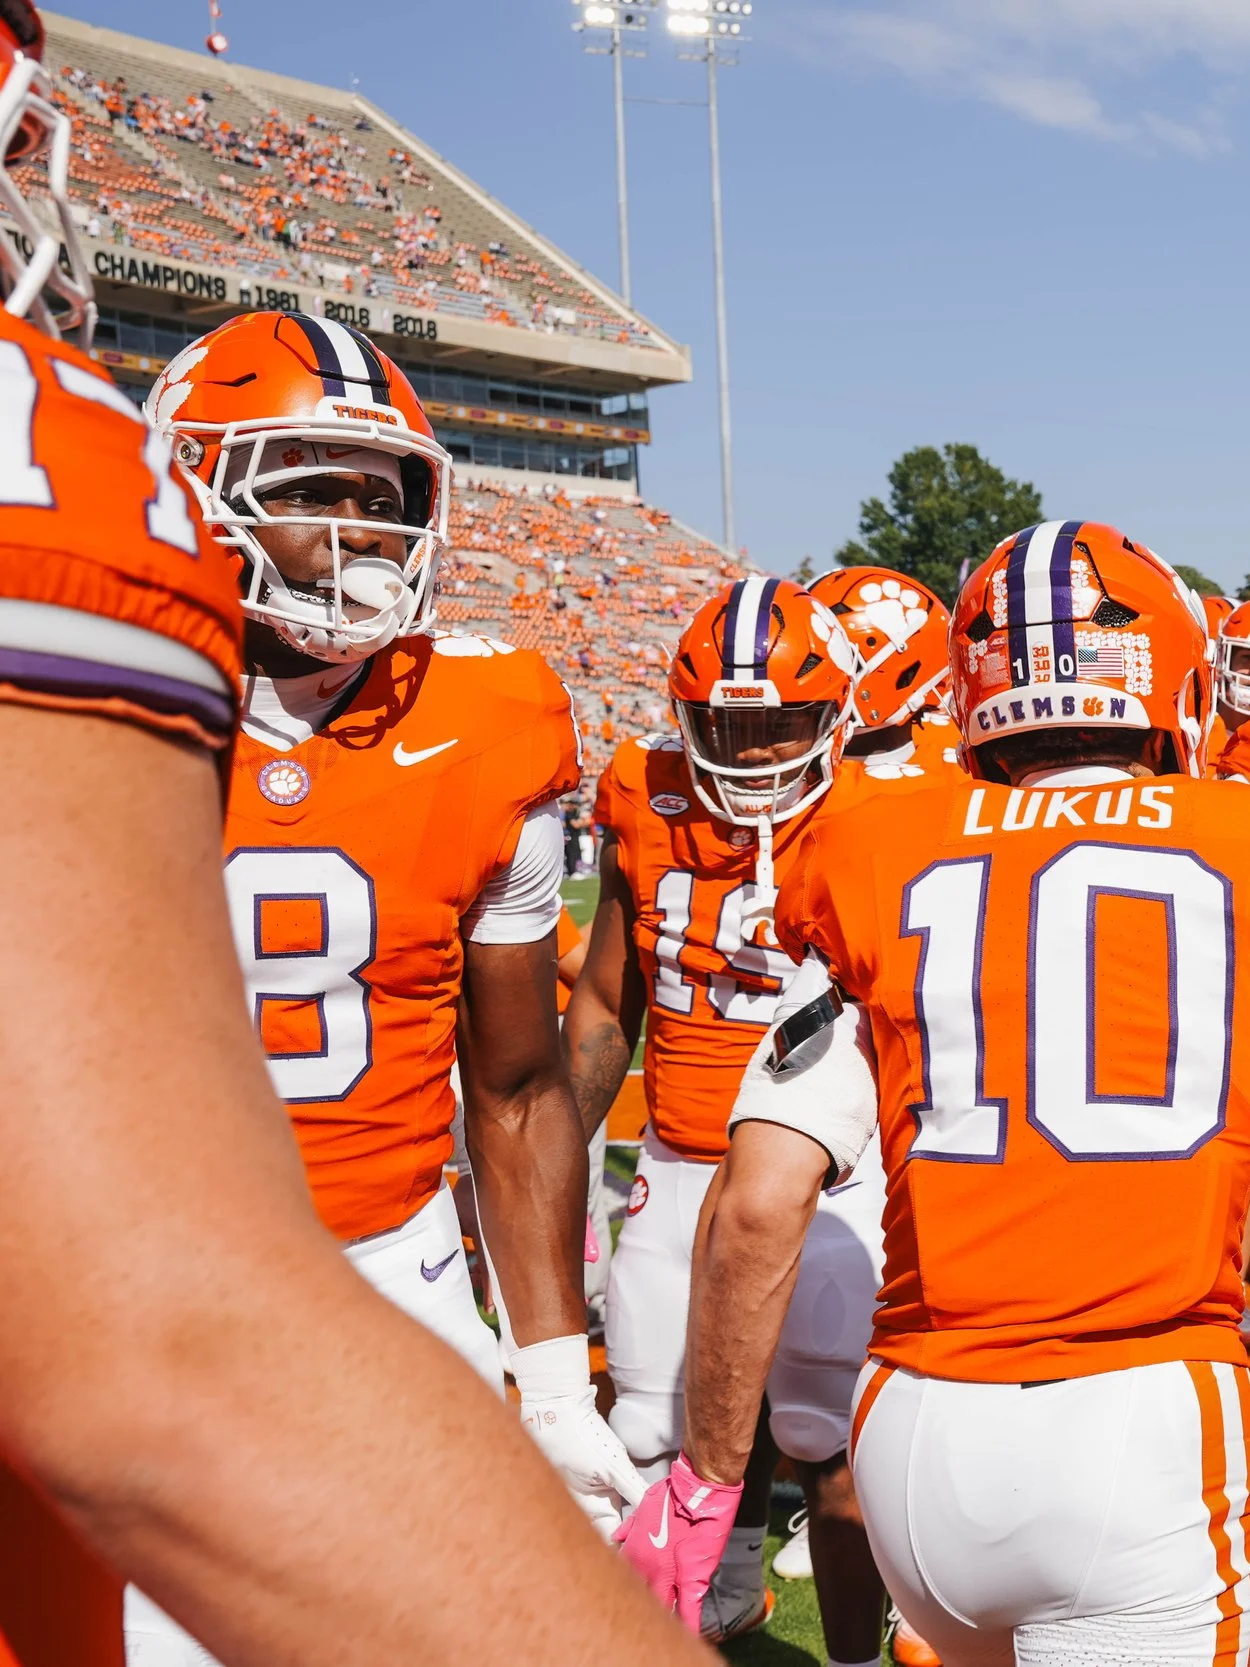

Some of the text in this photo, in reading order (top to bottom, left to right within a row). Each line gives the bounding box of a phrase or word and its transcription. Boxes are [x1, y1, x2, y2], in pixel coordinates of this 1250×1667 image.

[94, 250, 227, 300] CHAMPIONS
[255, 285, 301, 314] 1981
[393, 313, 438, 340] 2018
[332, 404, 398, 426] TIGERS
[1012, 657, 1025, 680] 1
[1058, 654, 1075, 677] 0
[720, 687, 764, 699] TIGERS
[261, 760, 308, 777] CLEMSON
[260, 785, 309, 804] GRADUATE
[656, 798, 684, 810] ACC
[963, 784, 1174, 837] LUKUS
[224, 845, 378, 1104] 8
[898, 839, 1235, 1164] 10
